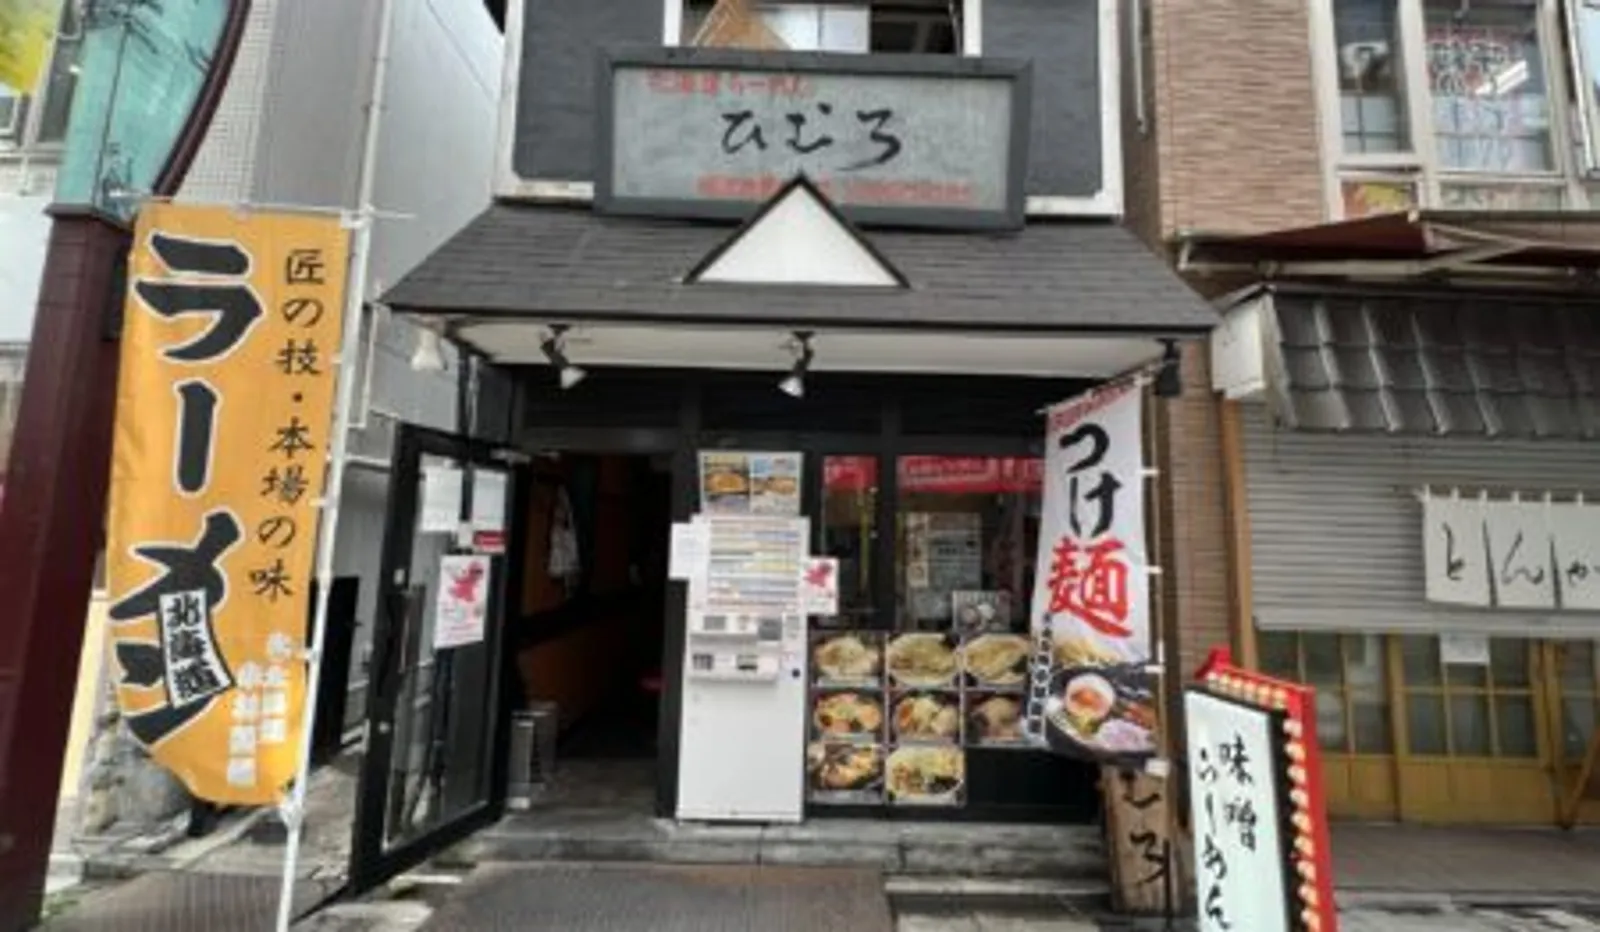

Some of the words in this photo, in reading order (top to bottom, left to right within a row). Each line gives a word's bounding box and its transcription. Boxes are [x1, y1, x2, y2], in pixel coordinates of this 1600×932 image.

[720, 103, 902, 171] ひむろ
[106, 231, 265, 746] ラーメン
[249, 249, 325, 604] 匠の技・本場の味
[1047, 423, 1133, 638] つけ麺
[1197, 747, 1234, 932] らーめん
[1219, 731, 1258, 853] 味噌
